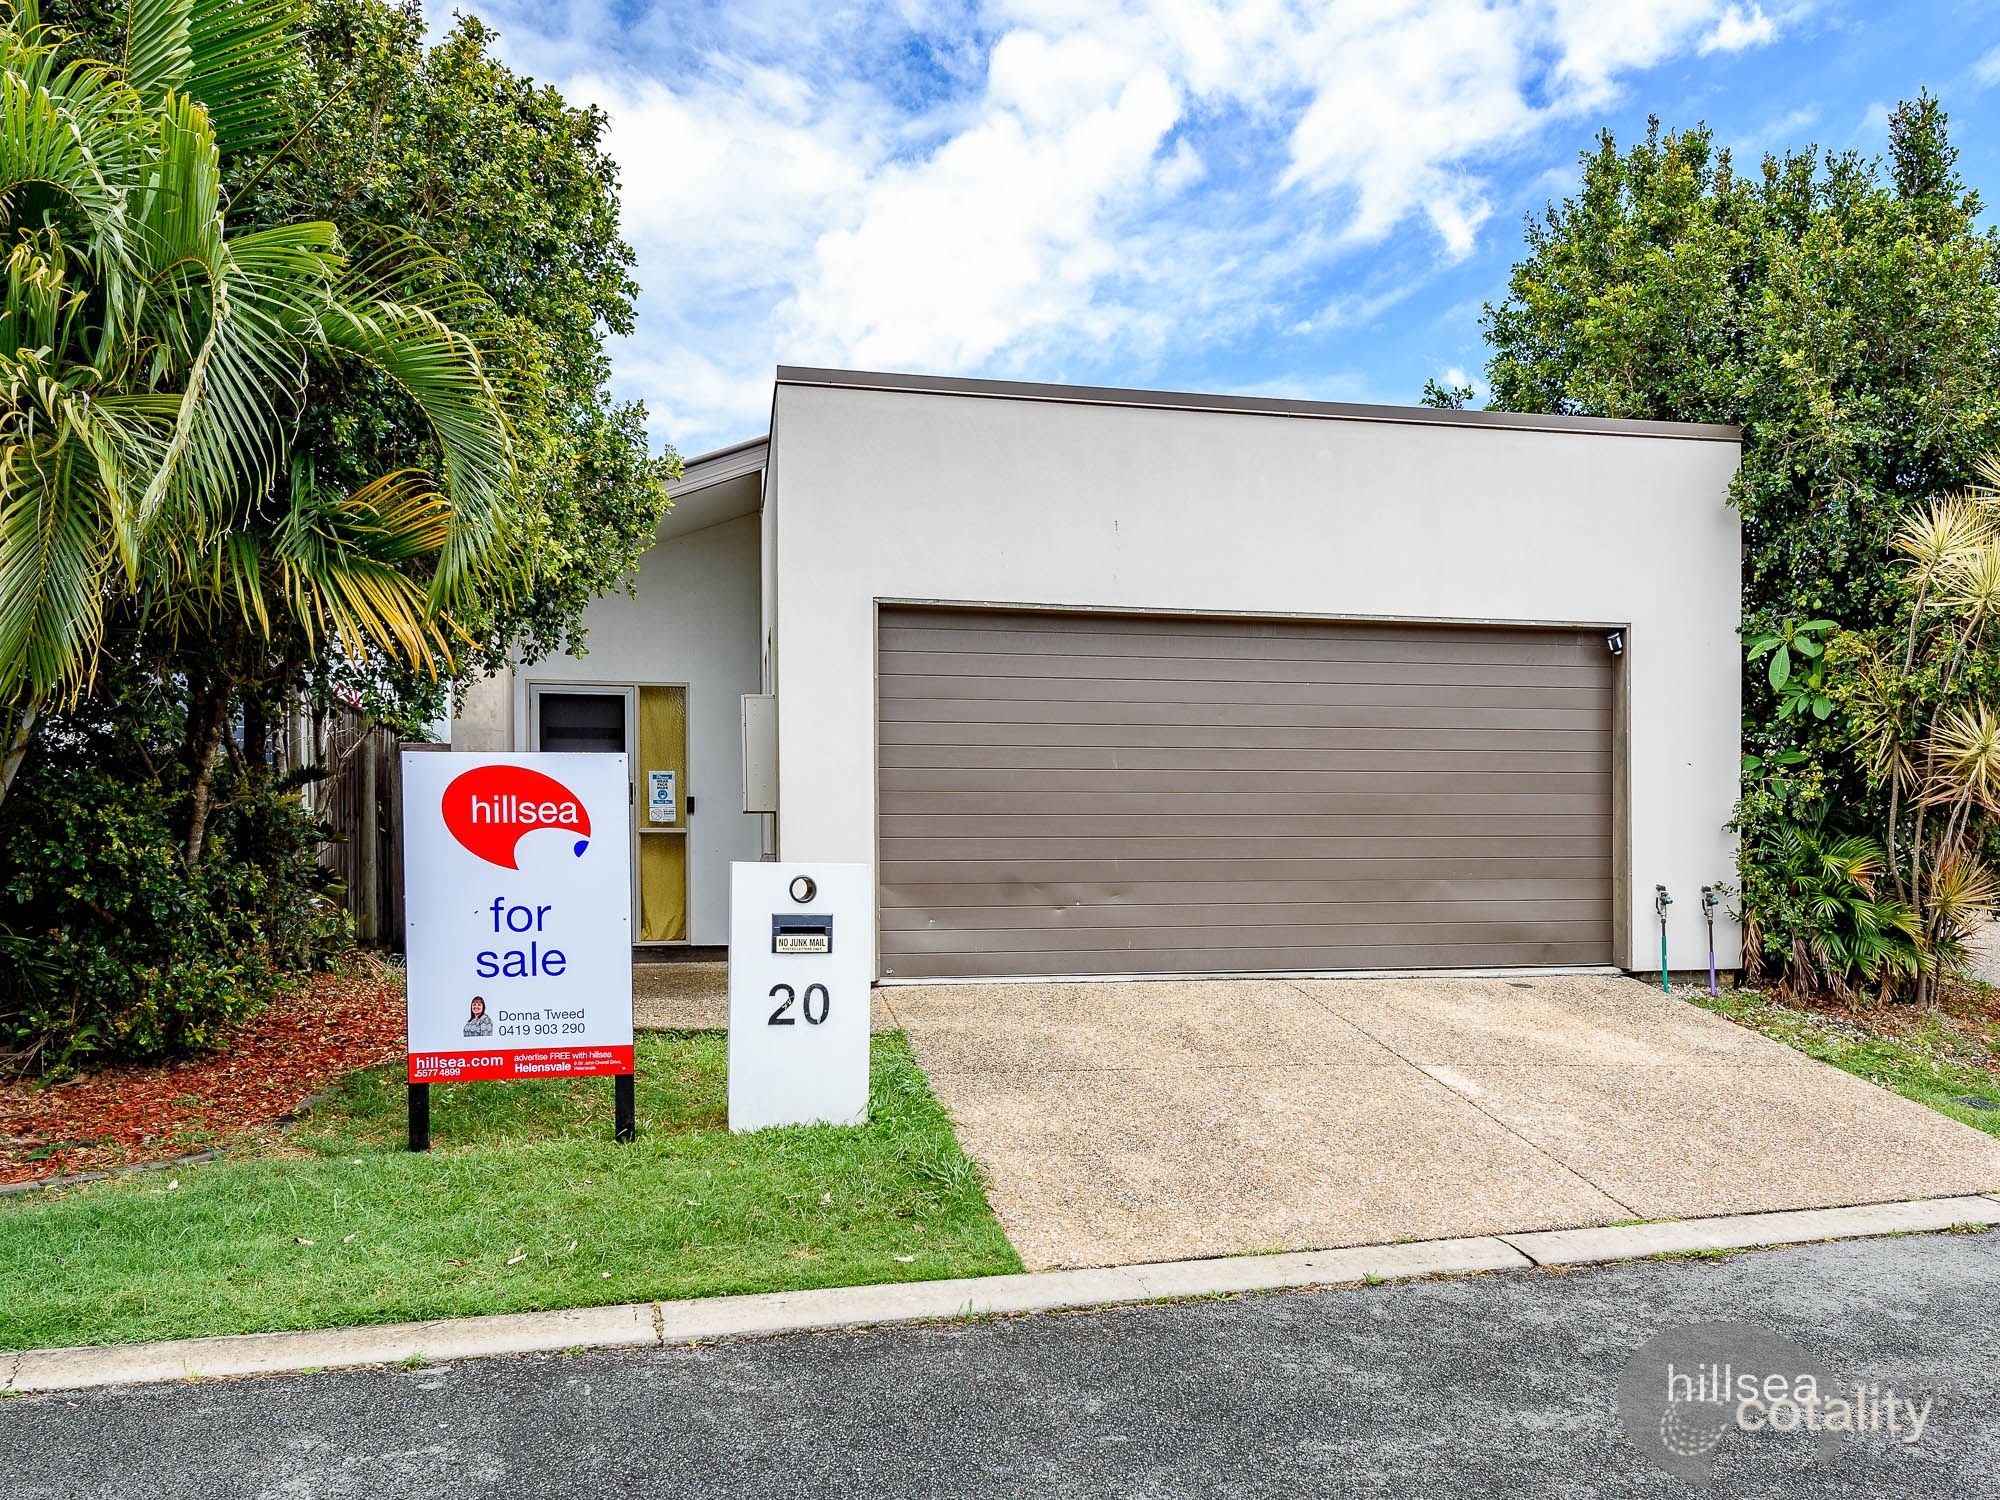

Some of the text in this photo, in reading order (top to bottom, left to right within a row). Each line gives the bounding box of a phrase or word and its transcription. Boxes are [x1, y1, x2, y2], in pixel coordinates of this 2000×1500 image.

[471, 794, 579, 824] hillsea
[489, 896, 552, 932] for
[778, 938, 826, 947] NO JUNK MAIL
[476, 941, 567, 978] sale
[767, 983, 830, 1026] 20
[499, 1008, 585, 1022] Donna Tweed
[499, 1023, 585, 1036] 0419 903 290
[416, 1056, 504, 1069] hillsea.com
[513, 1053, 548, 1061] advertise
[549, 1052, 571, 1060] FREE
[572, 1051, 588, 1059] with
[416, 1068, 461, 1077] 5577 4899
[514, 1061, 572, 1073] Helensvale
